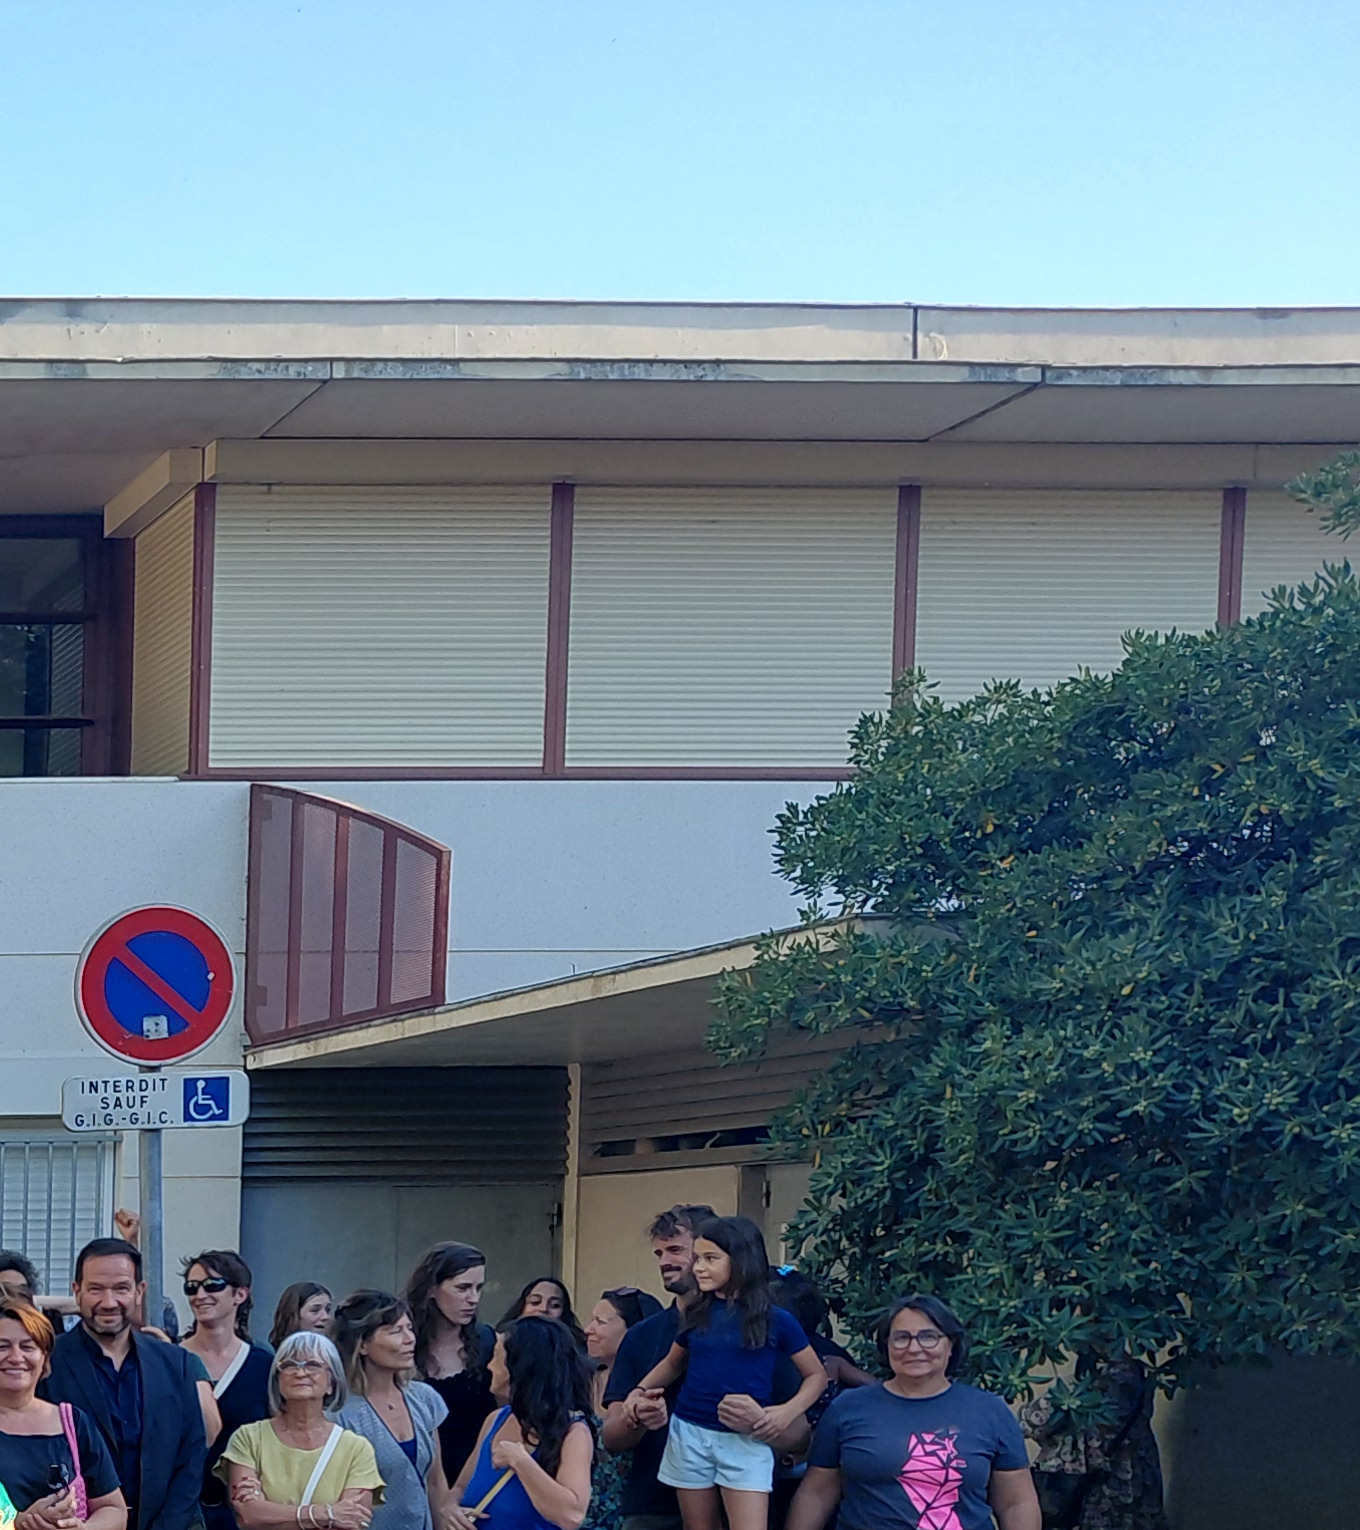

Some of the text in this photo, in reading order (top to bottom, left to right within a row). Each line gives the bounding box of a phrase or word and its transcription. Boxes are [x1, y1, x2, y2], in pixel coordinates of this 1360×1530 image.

[81, 1078, 168, 1094] INTERDIT
[100, 1096, 149, 1110] SAUF
[75, 1111, 174, 1127] G.I.G.-G.I.C.
